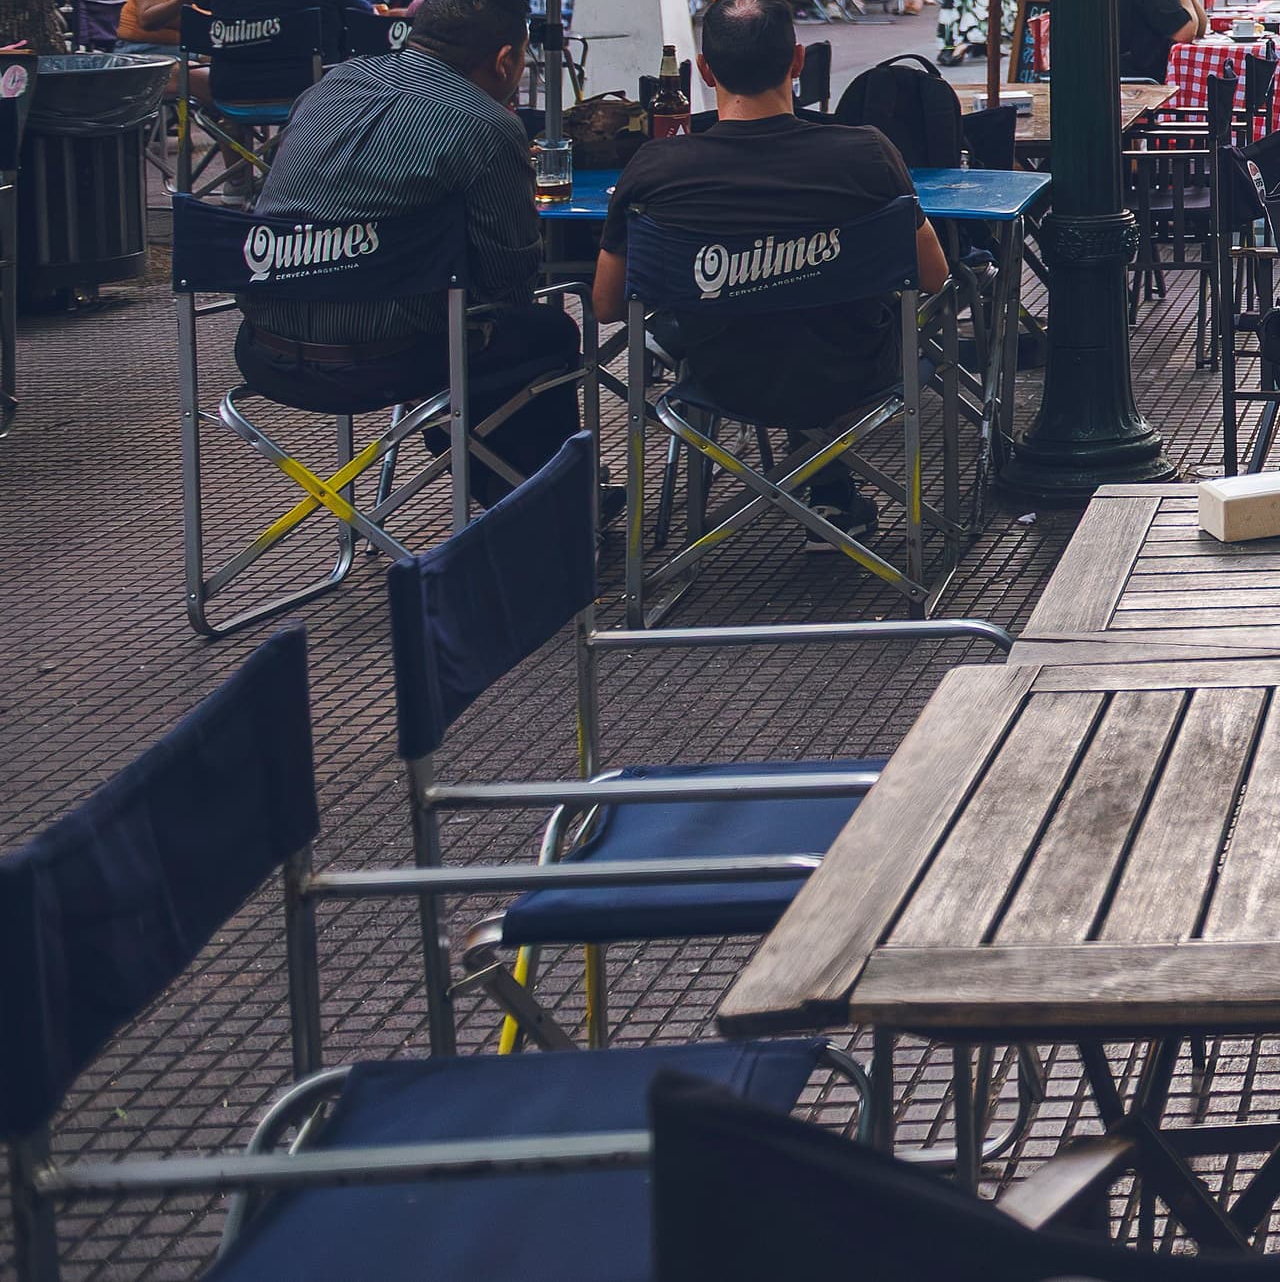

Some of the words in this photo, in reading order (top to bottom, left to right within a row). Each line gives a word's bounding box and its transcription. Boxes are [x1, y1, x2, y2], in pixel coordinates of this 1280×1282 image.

[209, 17, 282, 48] Quilmes
[243, 222, 380, 282] Quilmes
[693, 227, 841, 299] Quilmes
[275, 272, 316, 281] CERVEZA
[313, 262, 359, 275] ARGENTINA
[728, 287, 768, 298] CERVEZA
[770, 271, 822, 290] ARGENTINA
